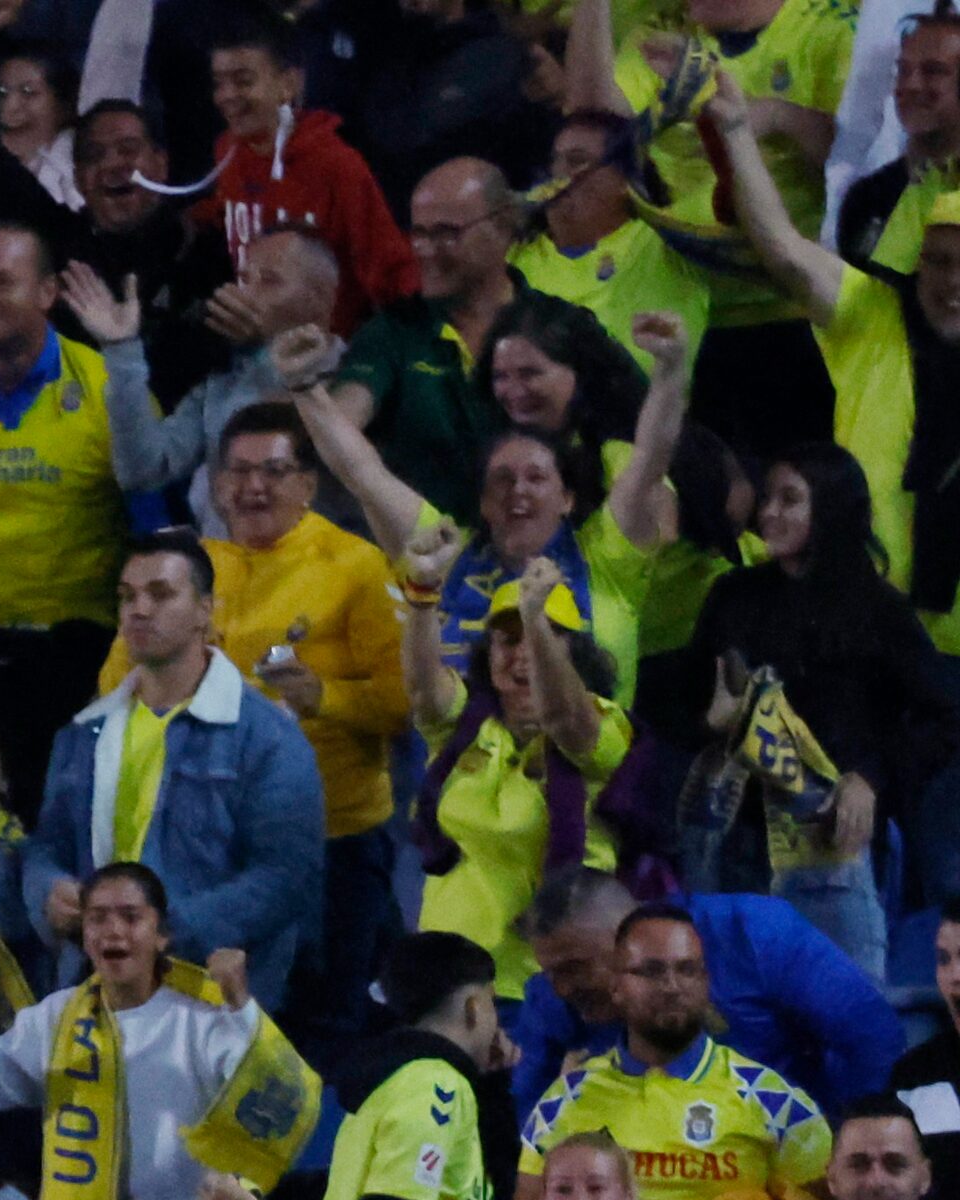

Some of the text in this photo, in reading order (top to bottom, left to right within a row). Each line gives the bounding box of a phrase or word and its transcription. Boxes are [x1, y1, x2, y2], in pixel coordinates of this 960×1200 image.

[52, 1014, 101, 1185] UD LA
[634, 1151, 740, 1181] HUCAS
